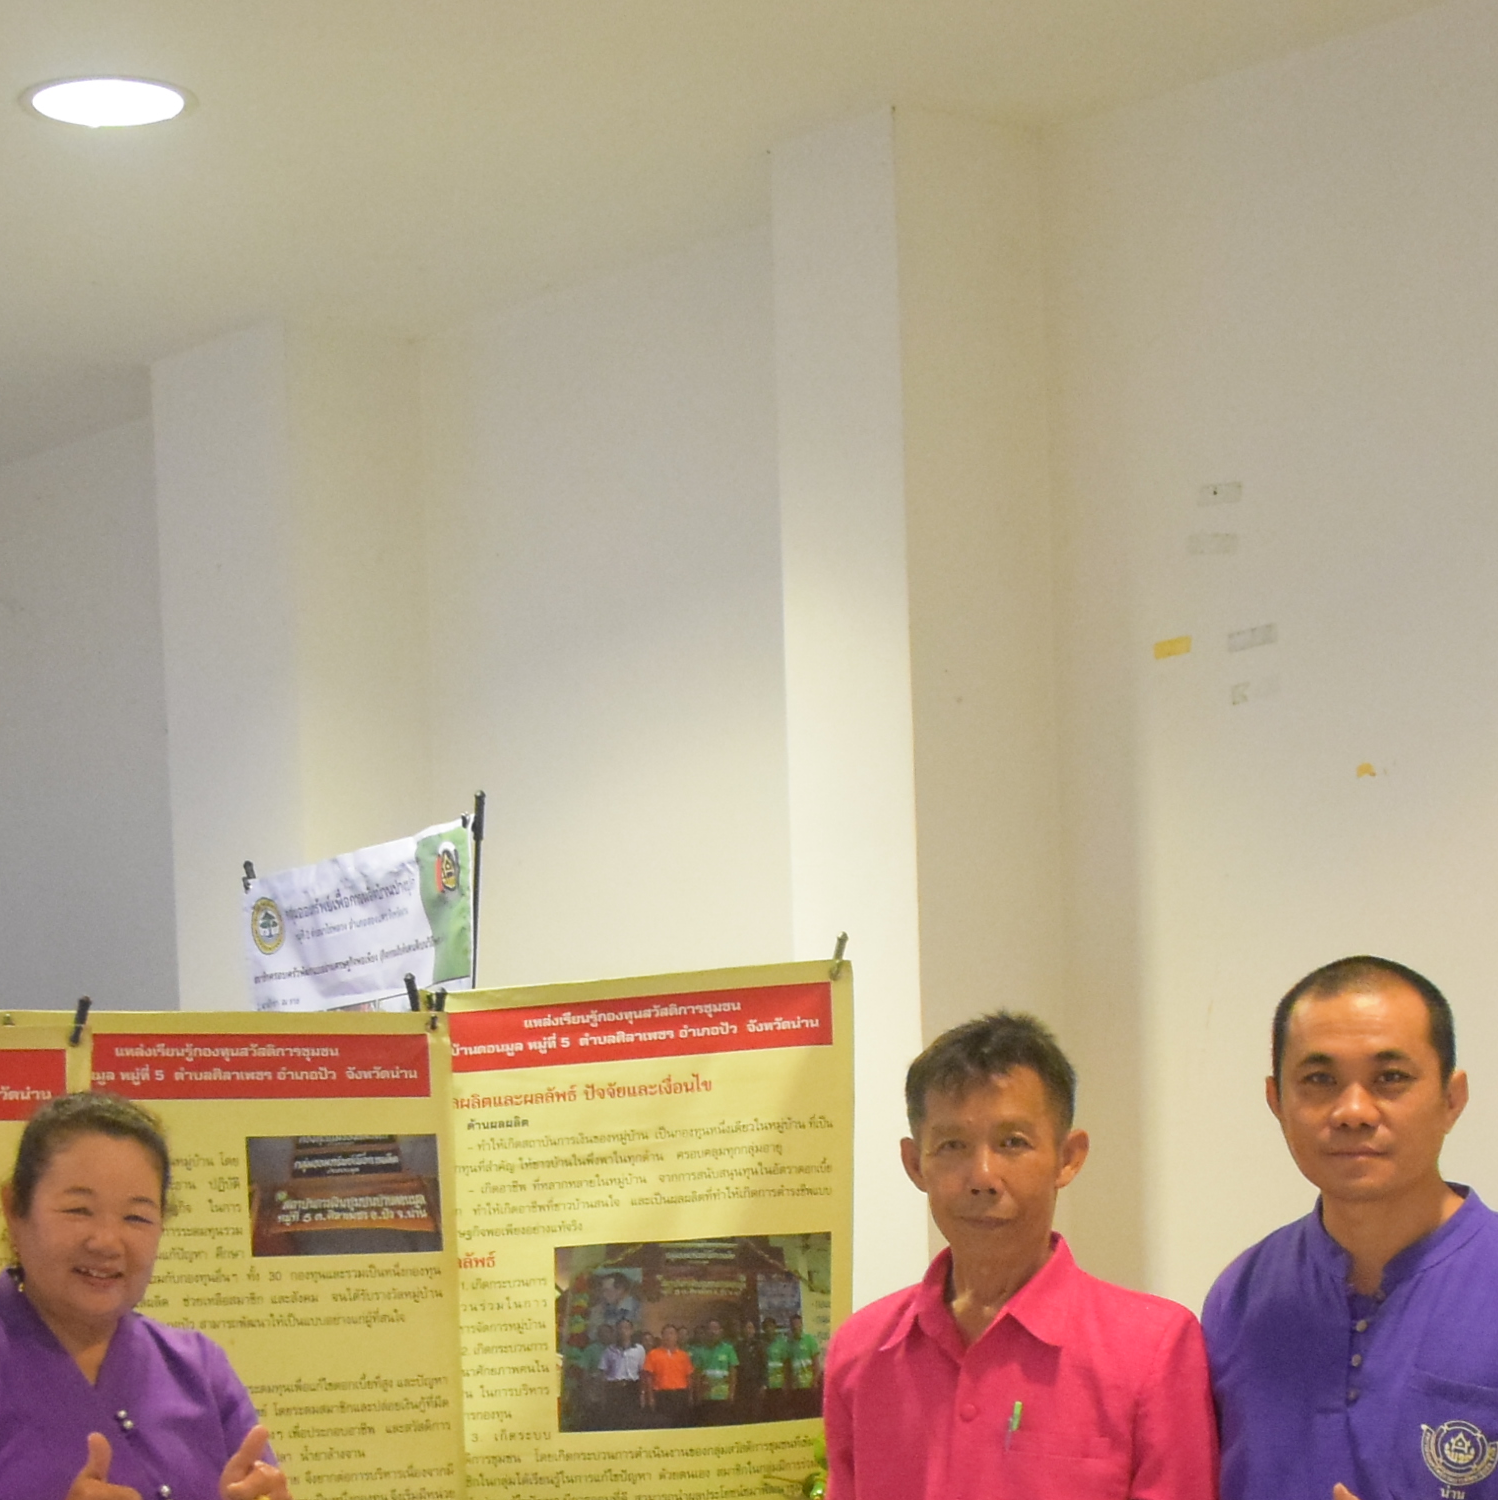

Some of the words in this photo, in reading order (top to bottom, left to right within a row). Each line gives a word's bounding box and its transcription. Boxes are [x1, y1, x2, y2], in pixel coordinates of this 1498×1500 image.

[523, 998, 742, 1030] แหล่งเรียนรู้กองทุนสวัสดิการชุมชน
[528, 1032, 558, 1054] หมู่ที่
[560, 1035, 571, 1049] 5
[578, 1026, 675, 1048] ตำบลศิลาเพชร
[678, 1022, 738, 1041] อำเภอปัว
[746, 1015, 820, 1036] จังหวัดน่าน
[114, 1040, 340, 1067] แหล่งเรียนรู้กองทุนสวัสดิการชุมชน
[120, 1064, 150, 1087] หมู่ที่
[154, 1069, 165, 1082] 5
[173, 1066, 273, 1082] ตำบลศิลาเพชร
[277, 1064, 337, 1082] อำเภอปัว
[346, 1064, 419, 1081] จังหวัดน่าน
[584, 1073, 713, 1101] ปัจจัยและเงื่อนไข
[467, 1116, 530, 1132] ด้านผลผลิต
[268, 1271, 283, 1282] 30
[1439, 1484, 1466, 1500] น่าน
